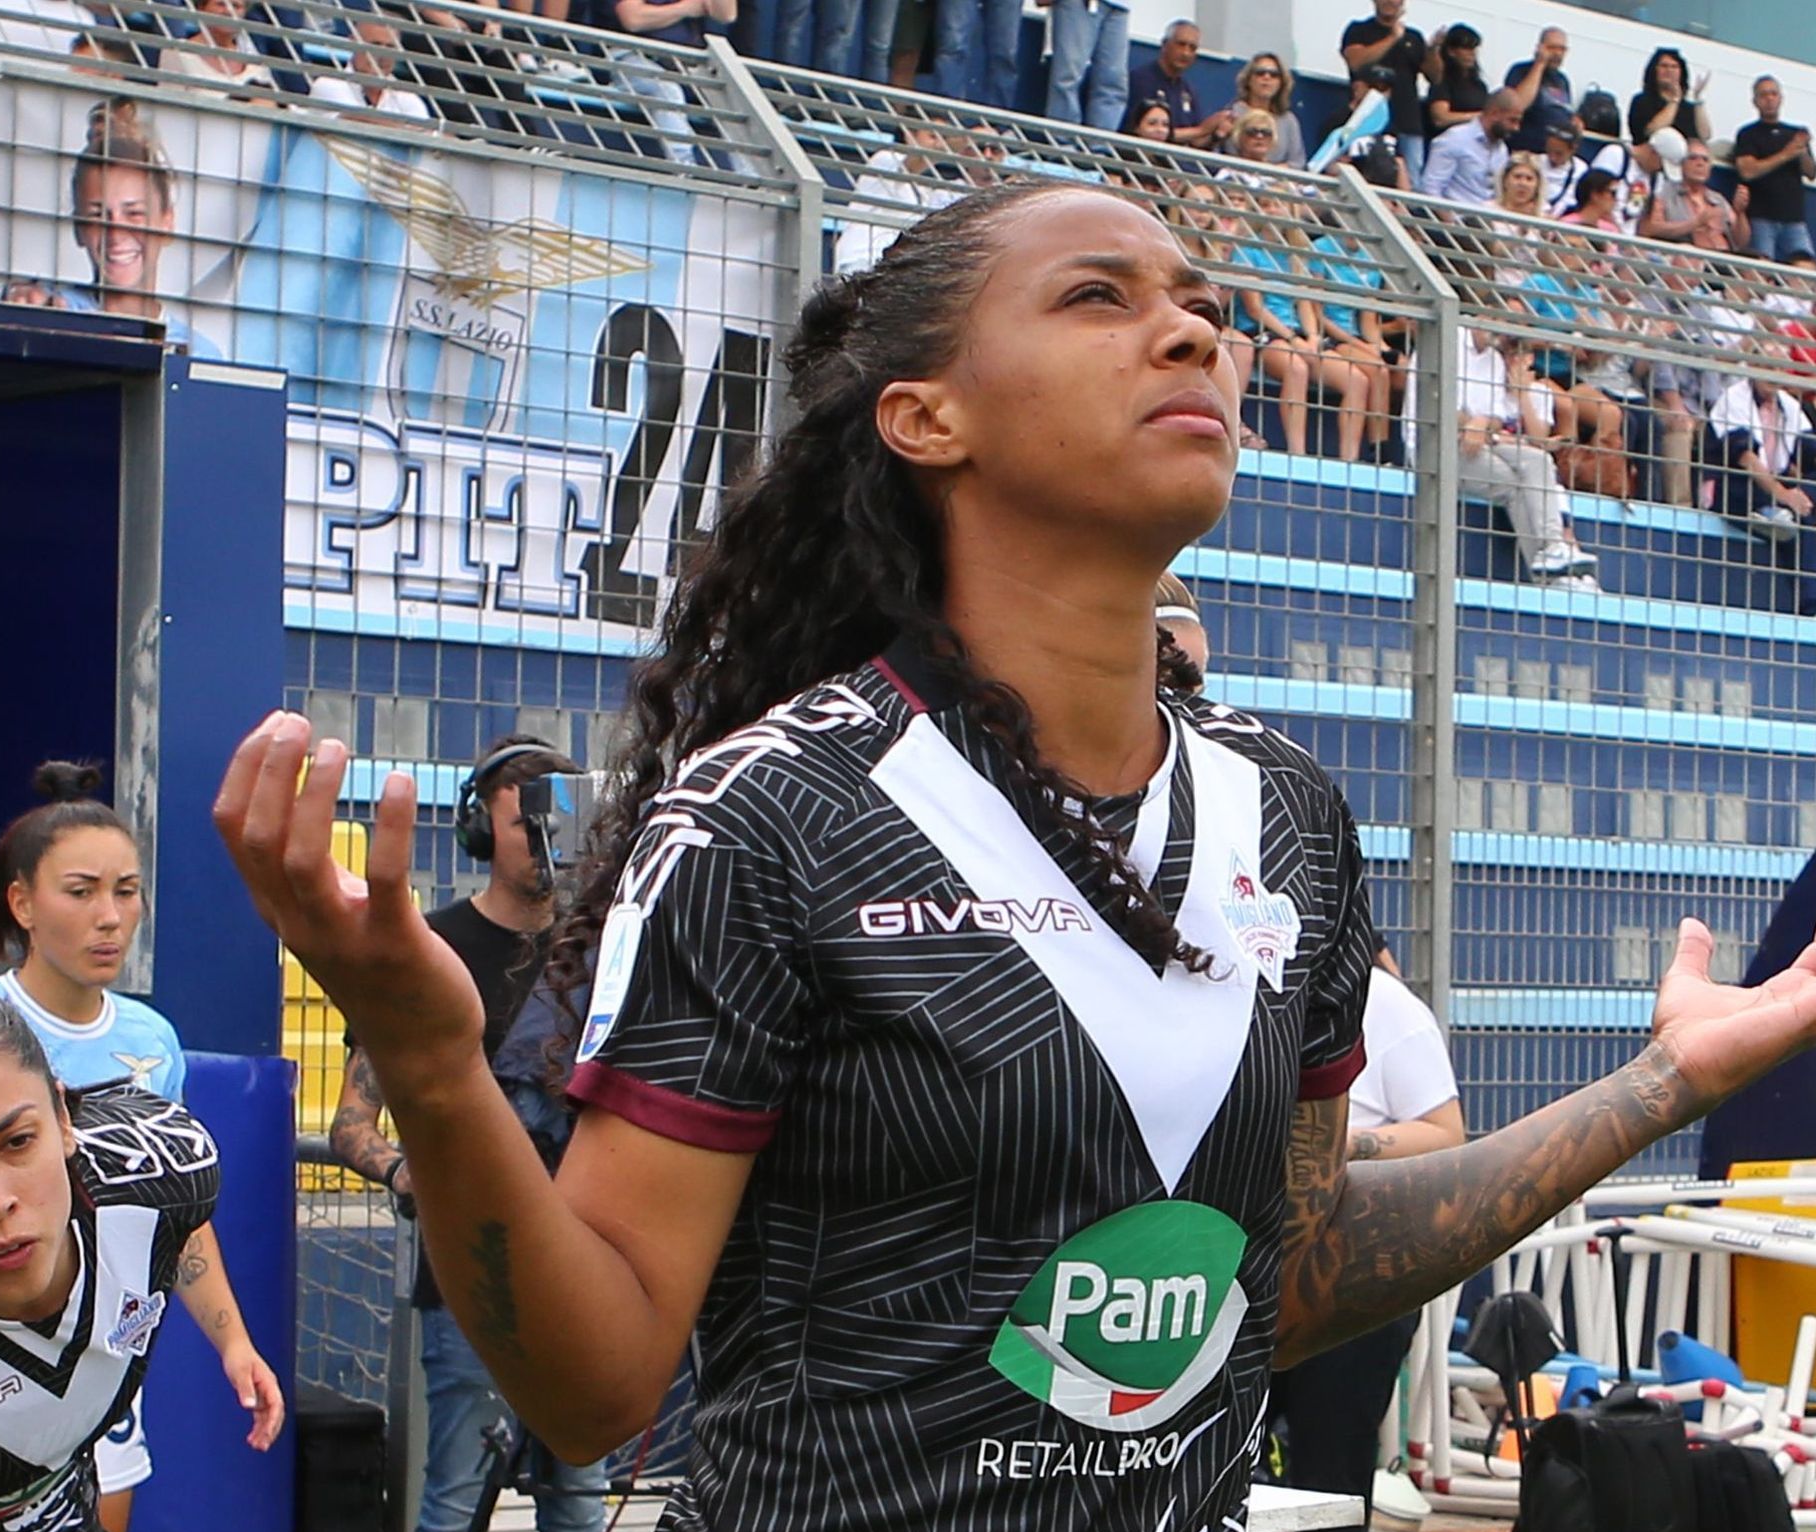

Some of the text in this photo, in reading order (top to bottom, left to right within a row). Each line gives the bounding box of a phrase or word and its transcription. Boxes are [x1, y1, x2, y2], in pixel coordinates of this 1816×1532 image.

[284, 405, 616, 620] PIT
[858, 898, 1093, 937] GIVOVA
[1048, 1261, 1207, 1343] Pam
